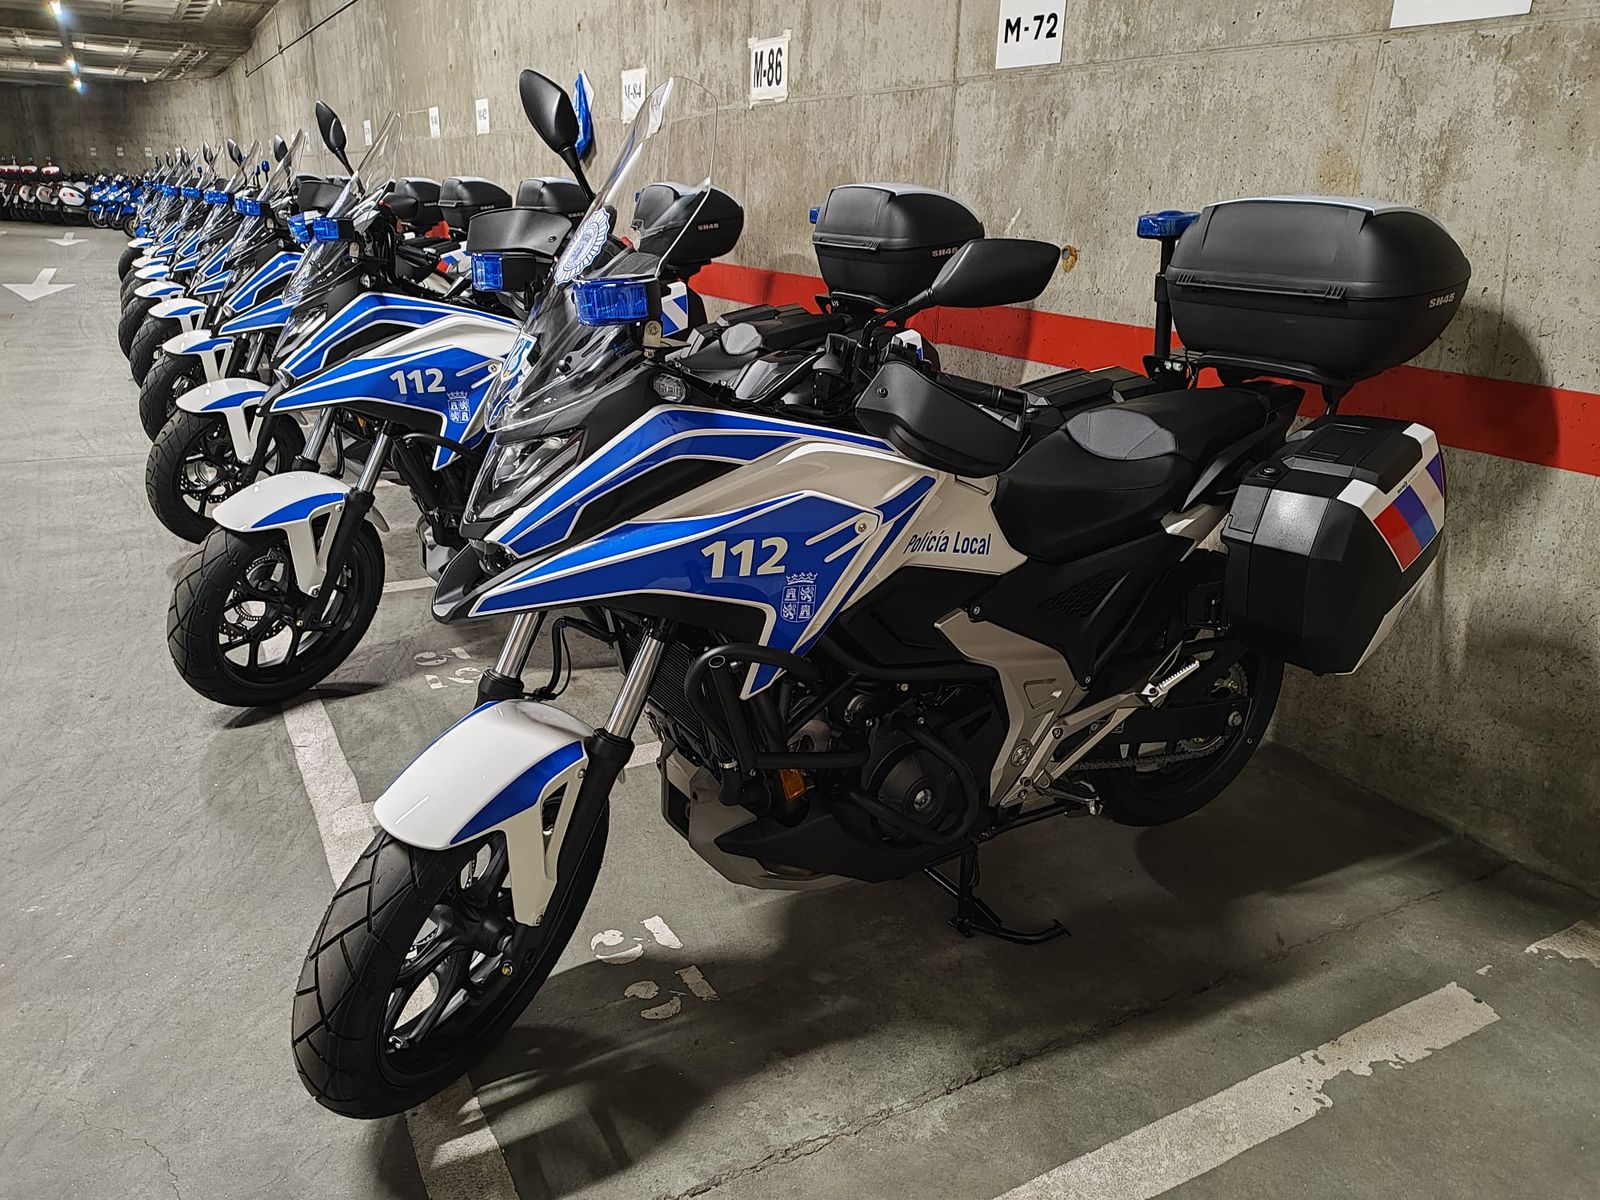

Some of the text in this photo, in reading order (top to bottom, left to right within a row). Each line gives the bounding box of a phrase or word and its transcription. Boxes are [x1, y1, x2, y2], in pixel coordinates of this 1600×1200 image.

[1004, 12, 1058, 44] M-72
[753, 47, 784, 88] M-86
[1429, 293, 1455, 308] SH45
[389, 367, 446, 395] 112
[701, 536, 787, 579] 112
[903, 530, 991, 556] Policía Local
